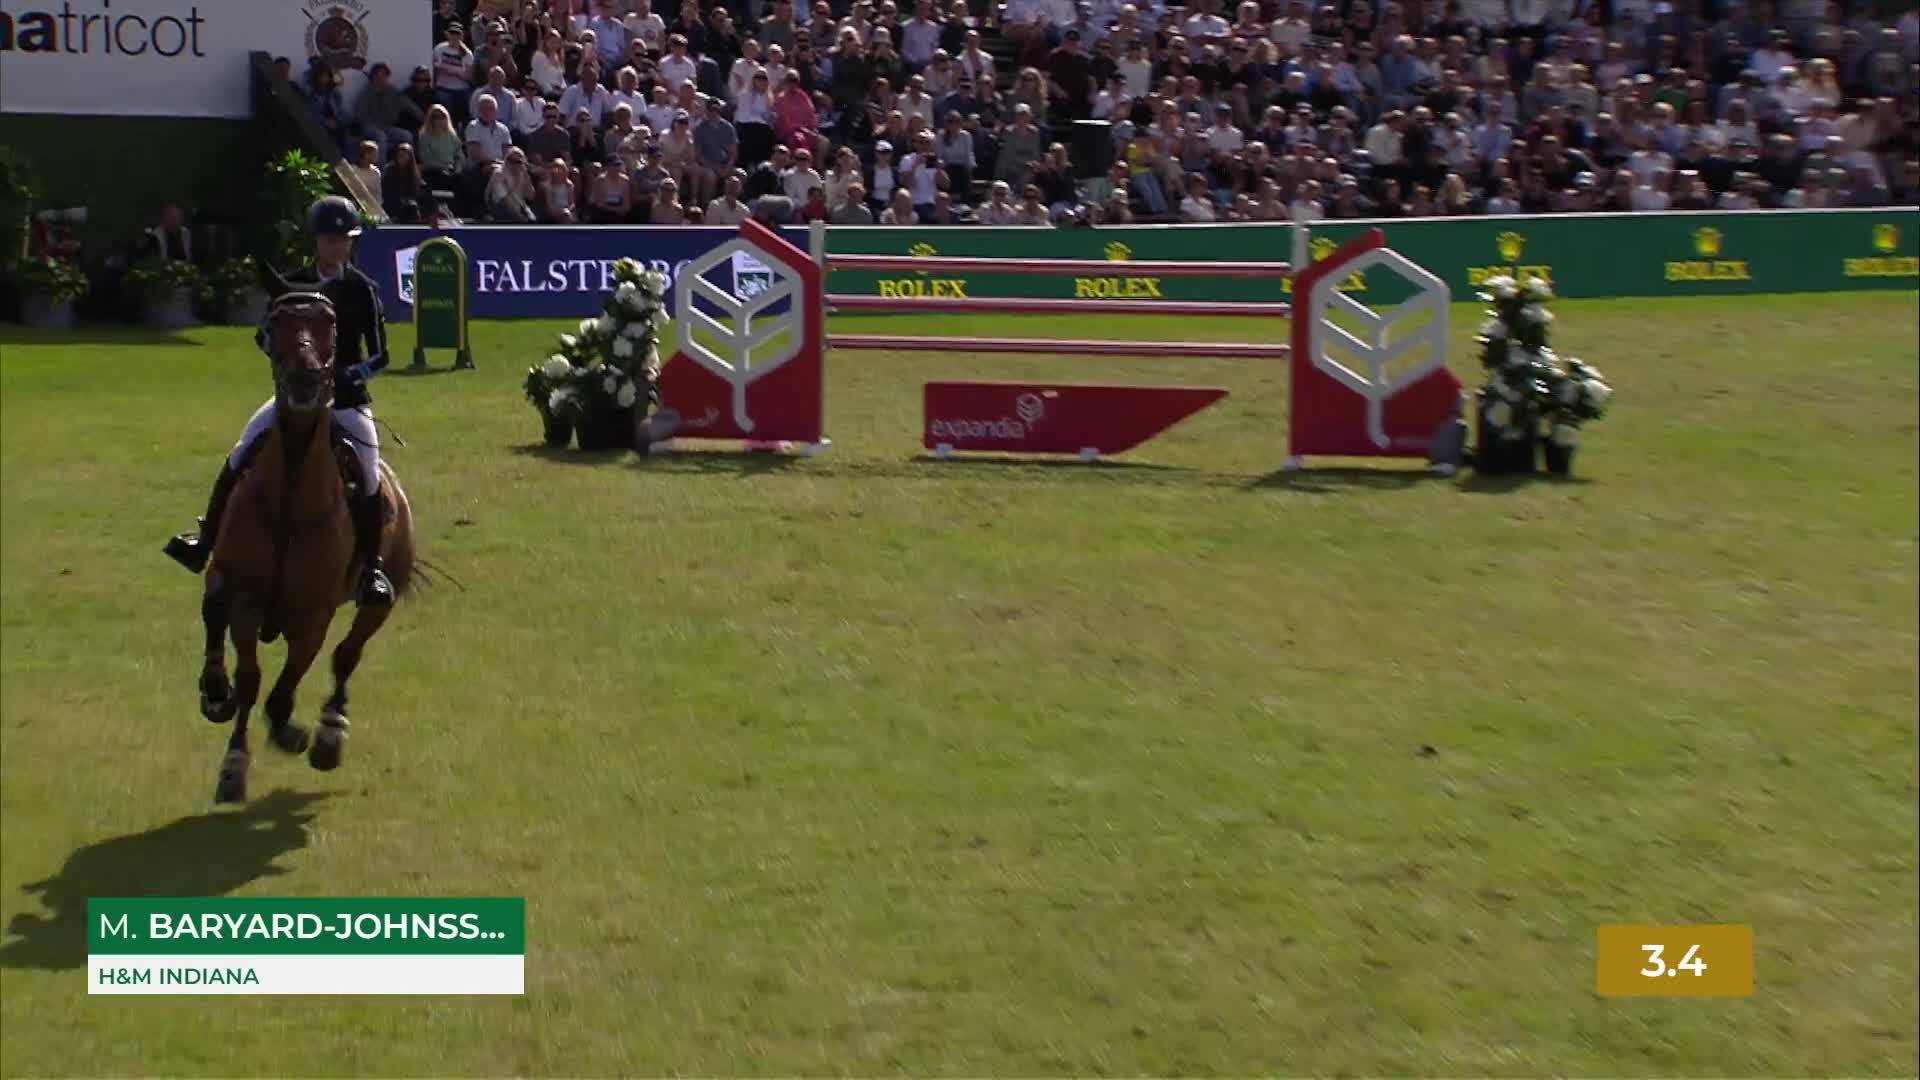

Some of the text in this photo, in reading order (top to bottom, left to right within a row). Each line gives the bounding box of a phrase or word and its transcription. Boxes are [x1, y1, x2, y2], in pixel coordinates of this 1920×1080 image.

[476, 259, 694, 292] FALSTEB
[878, 279, 967, 298] ROLEX
[1074, 277, 1161, 297] ROLEX
